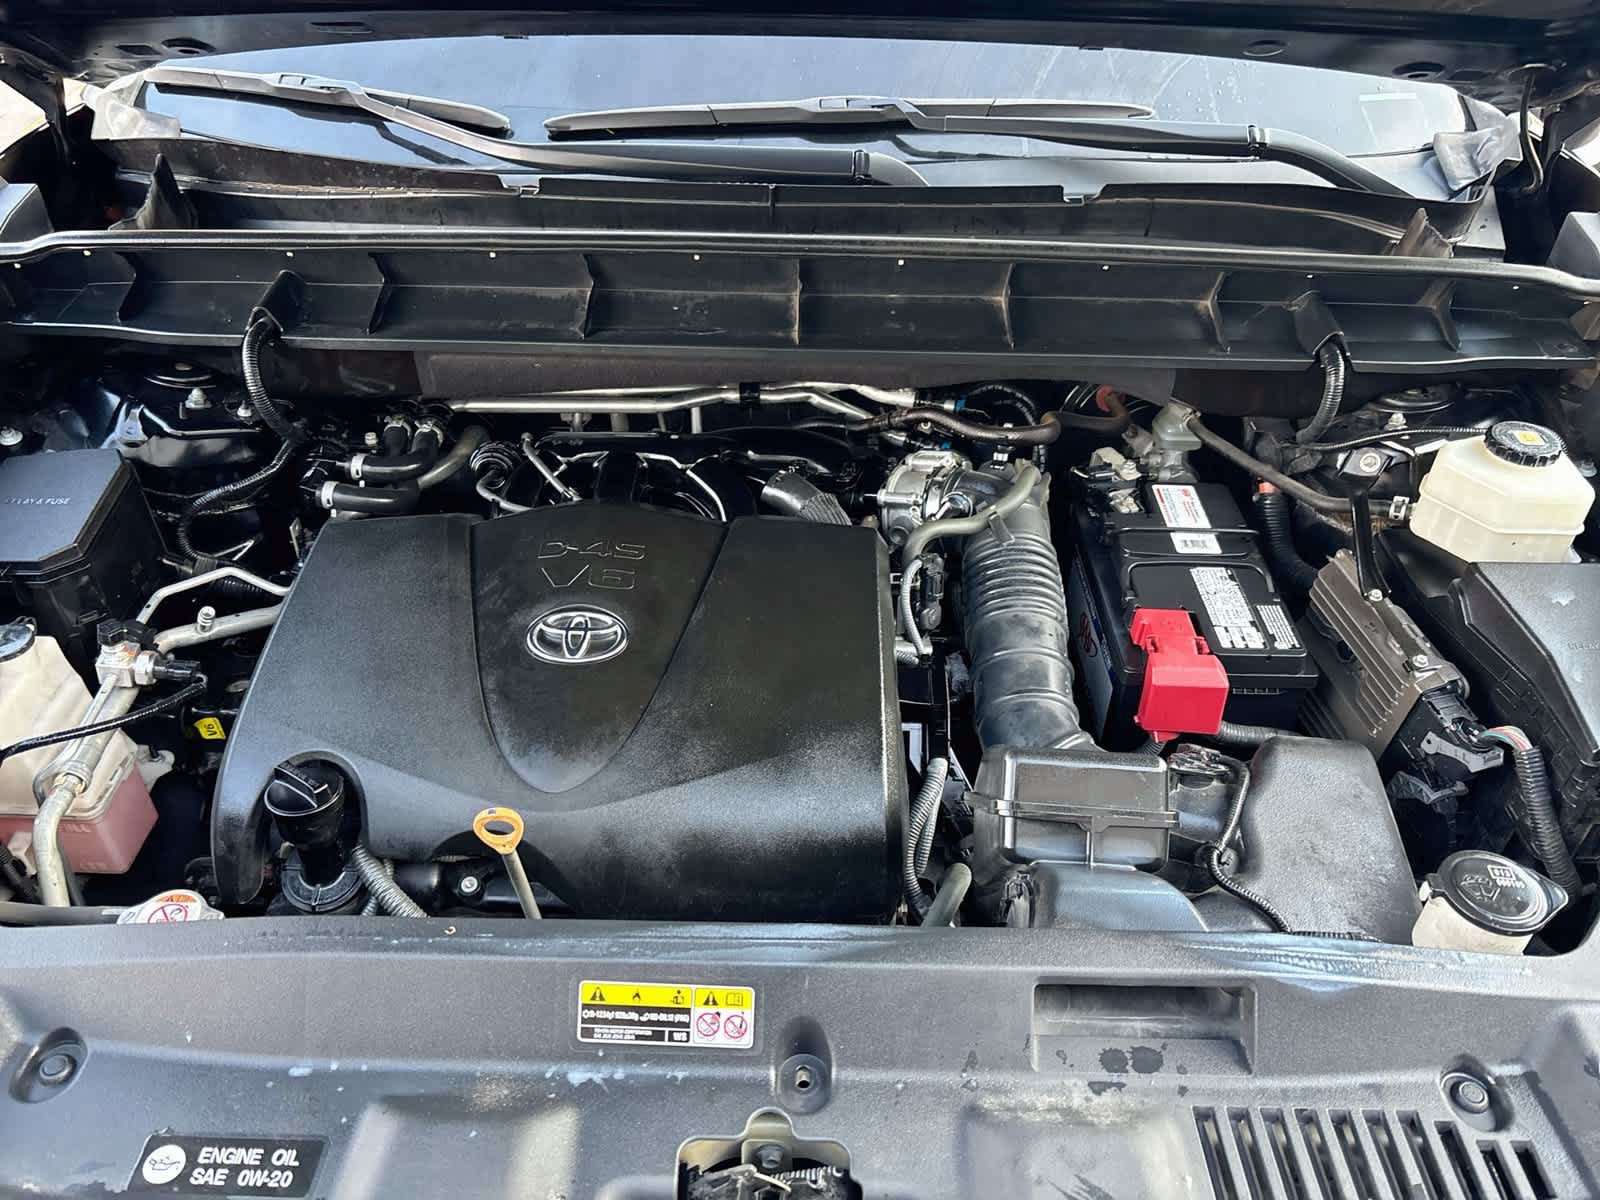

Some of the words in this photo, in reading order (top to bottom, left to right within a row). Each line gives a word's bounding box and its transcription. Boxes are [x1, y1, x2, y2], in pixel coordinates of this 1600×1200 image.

[537, 540, 646, 560] D-4S
[541, 564, 636, 590] V6
[197, 1146, 264, 1165] ENGINE
[271, 1148, 299, 1166] OIL
[189, 1167, 229, 1185] SAE
[237, 1169, 293, 1188] 0W-20
